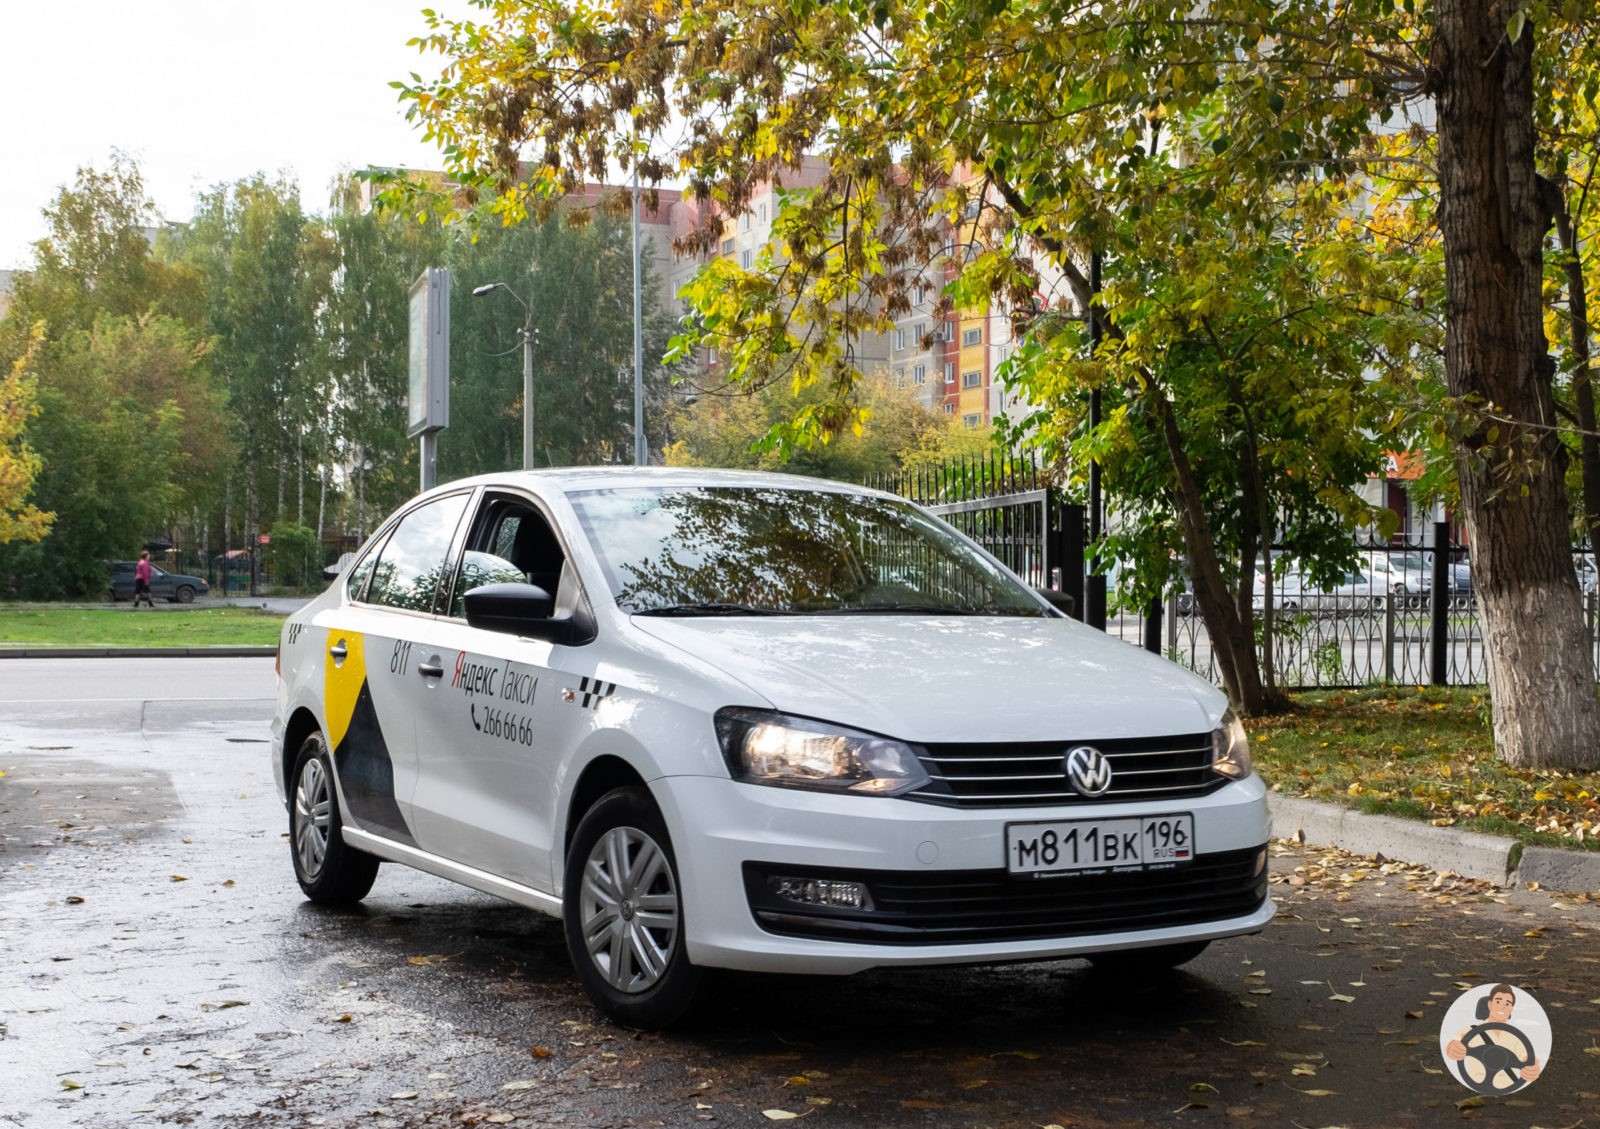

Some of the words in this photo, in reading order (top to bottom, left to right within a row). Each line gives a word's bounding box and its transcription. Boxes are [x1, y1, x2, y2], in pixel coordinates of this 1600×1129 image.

[391, 639, 411, 675] 811
[451, 650, 498, 696] Яндекс
[500, 659, 538, 705] Такси
[484, 706, 502, 738] 266
[503, 712, 517, 742] 66
[519, 716, 533, 746] 66
[1145, 819, 1185, 848] 196
[1153, 848, 1175, 859] RUS
